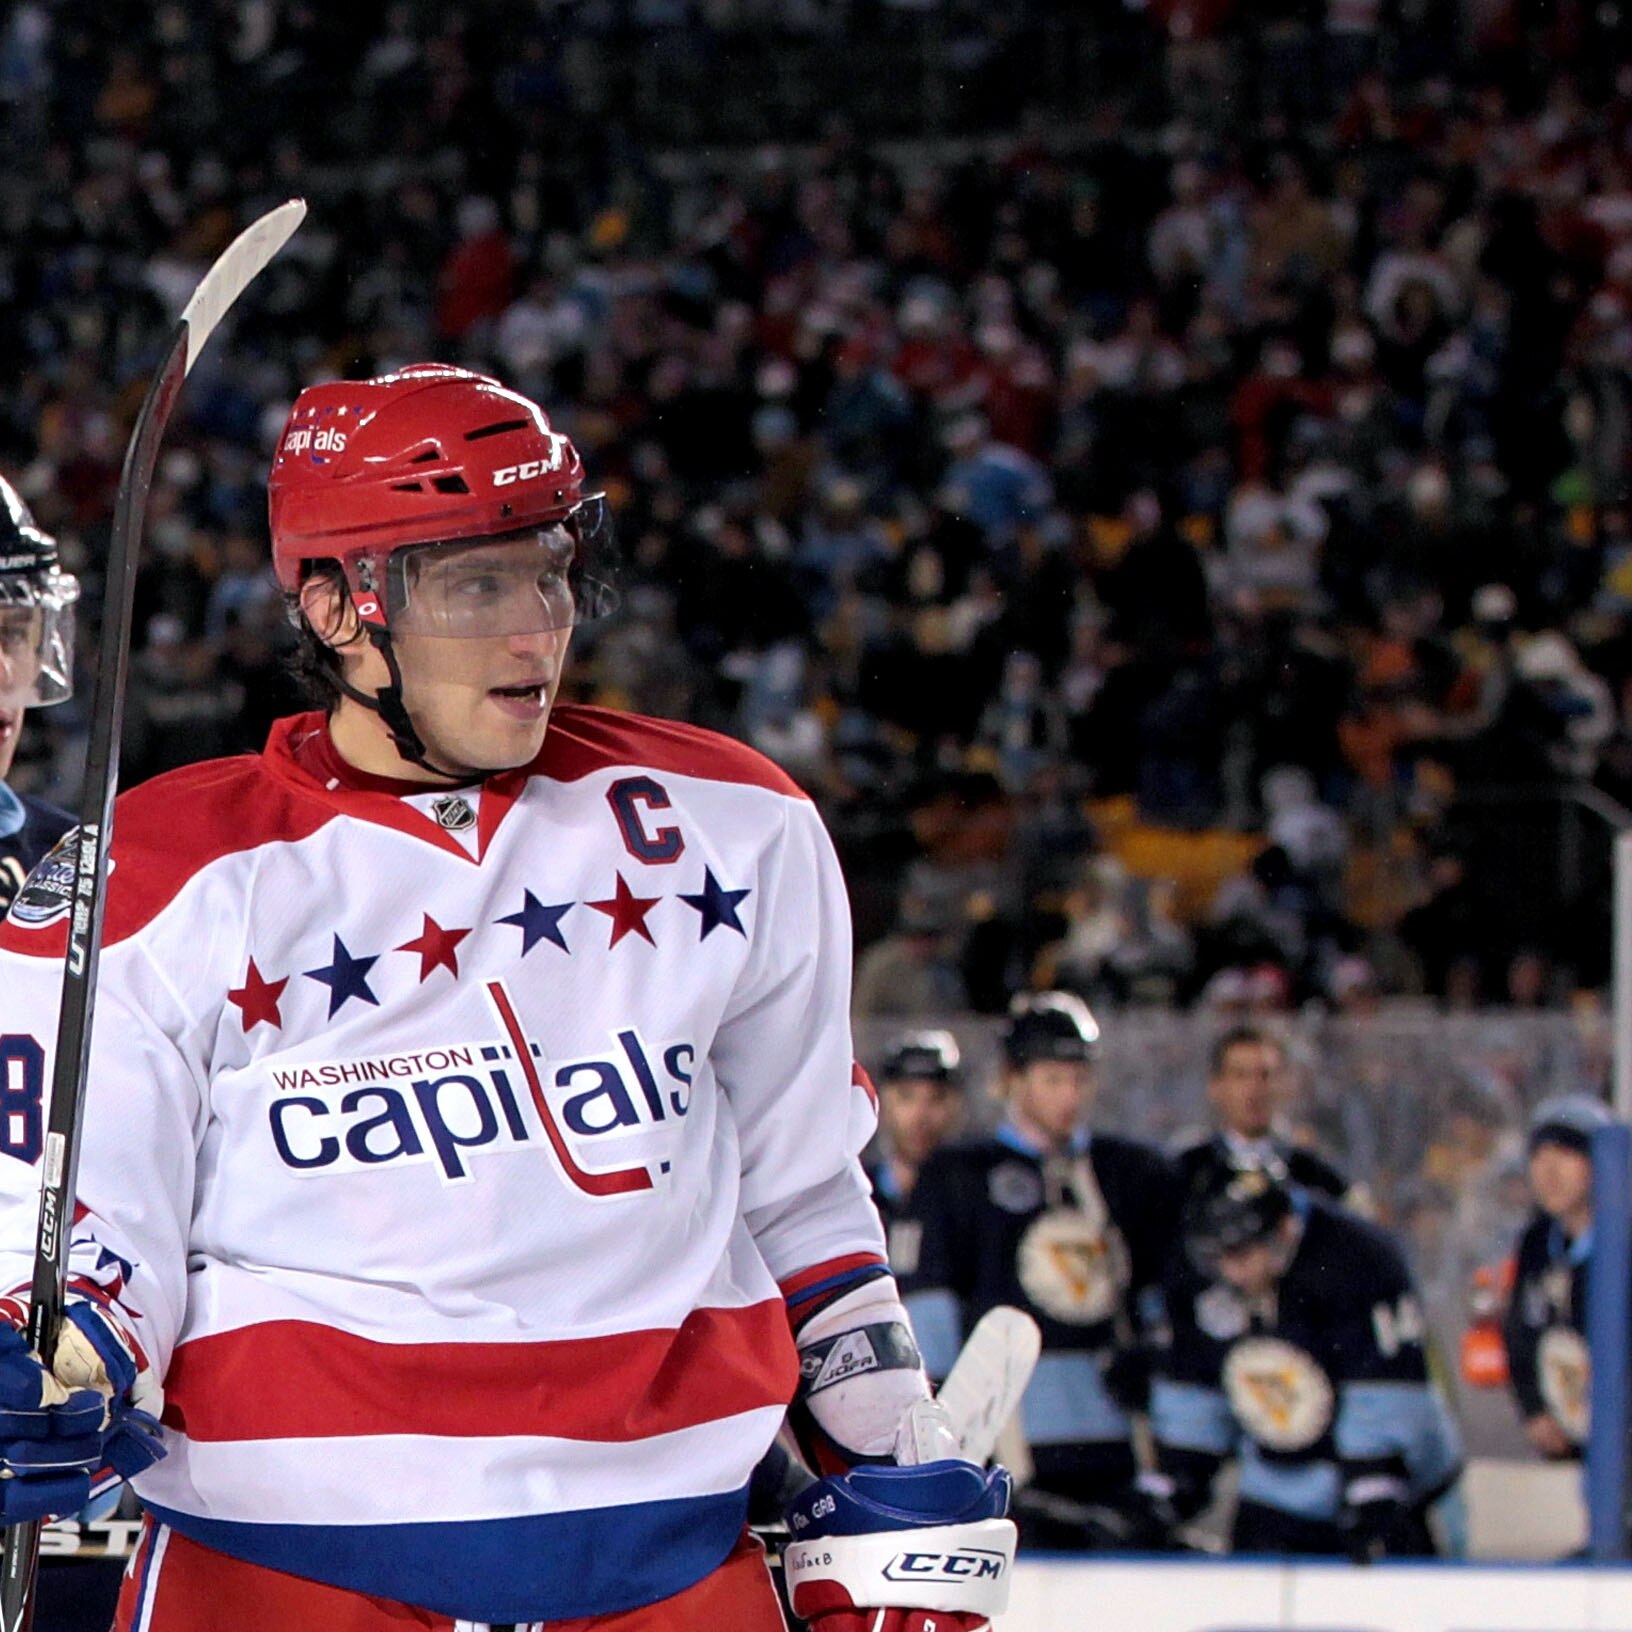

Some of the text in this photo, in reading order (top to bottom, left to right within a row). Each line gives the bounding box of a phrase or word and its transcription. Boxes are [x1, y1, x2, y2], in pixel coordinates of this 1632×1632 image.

[493, 460, 560, 487] CCM
[605, 775, 686, 865] C
[273, 1047, 473, 1091] WASHINGTON
[40, 1188, 58, 1253] CCM
[824, 1356, 873, 1382] JOFA
[900, 1552, 1002, 1580] CCM
